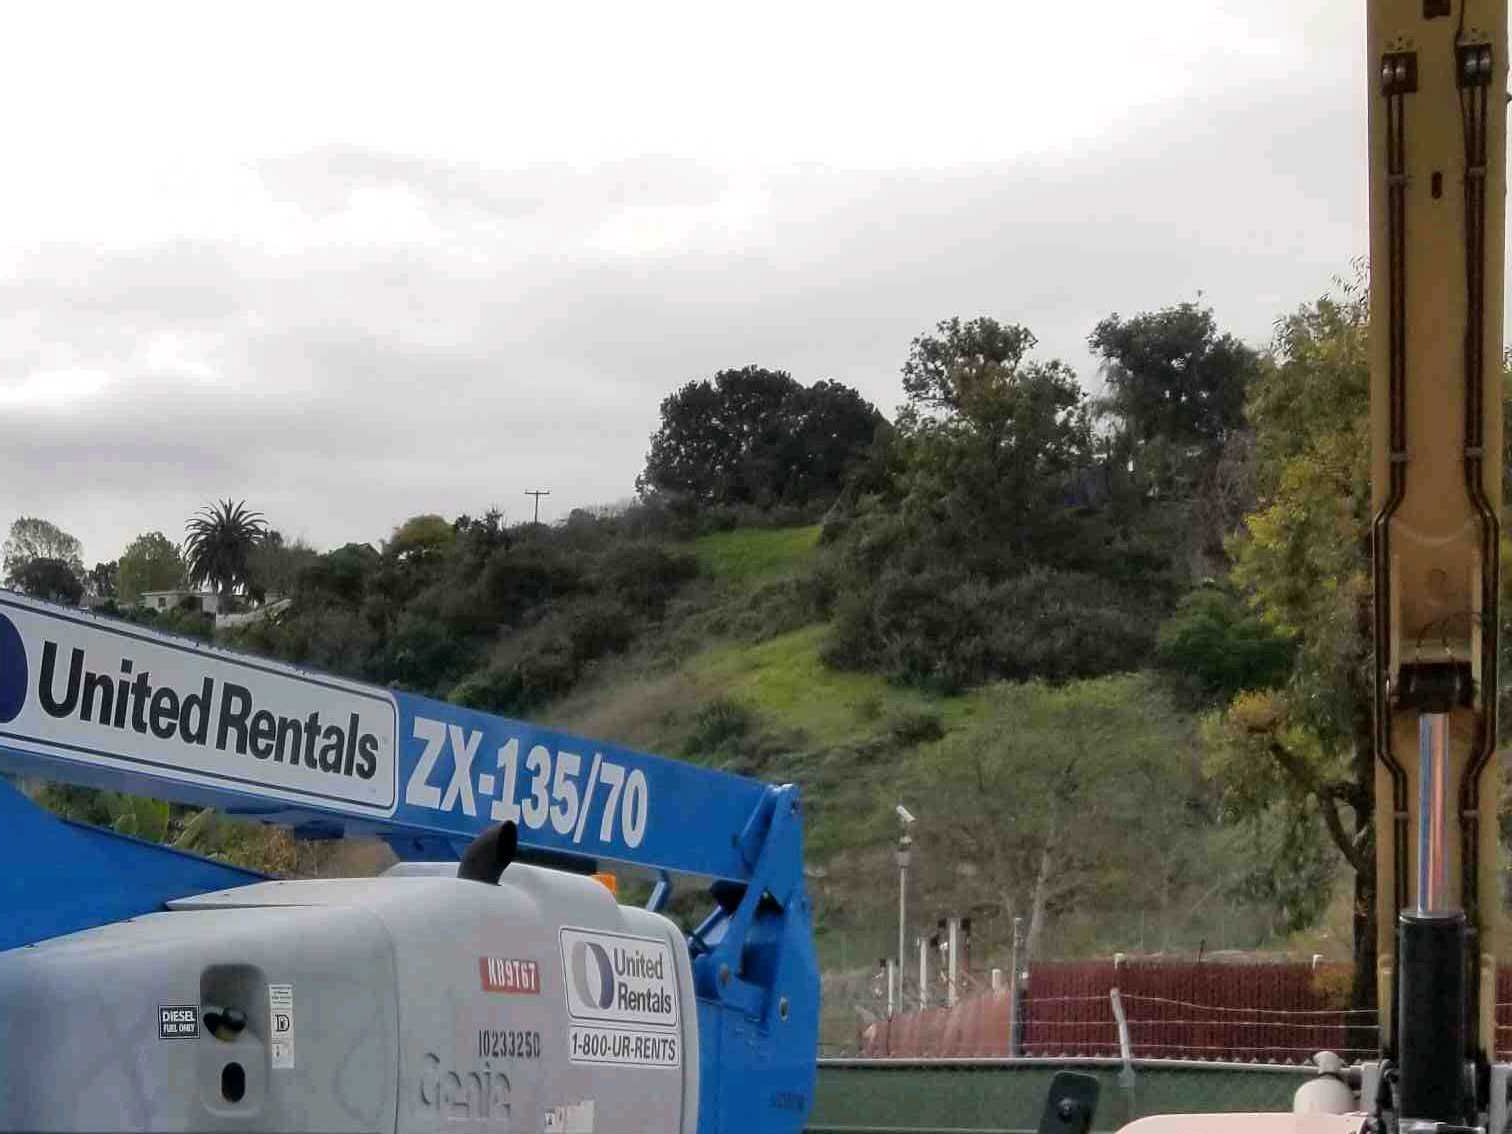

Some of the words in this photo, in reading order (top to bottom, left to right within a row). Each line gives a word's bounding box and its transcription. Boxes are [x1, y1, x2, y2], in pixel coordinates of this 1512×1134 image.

[38, 640, 215, 746] United
[215, 681, 379, 780] Rentals
[405, 716, 648, 848] ZX-135/70
[613, 948, 664, 979] United
[617, 983, 672, 1014] Rentals
[162, 1010, 196, 1022] DIESEL
[478, 1029, 541, 1058] 10233250
[572, 1033, 676, 1061] 1-800-UR-RENTS
